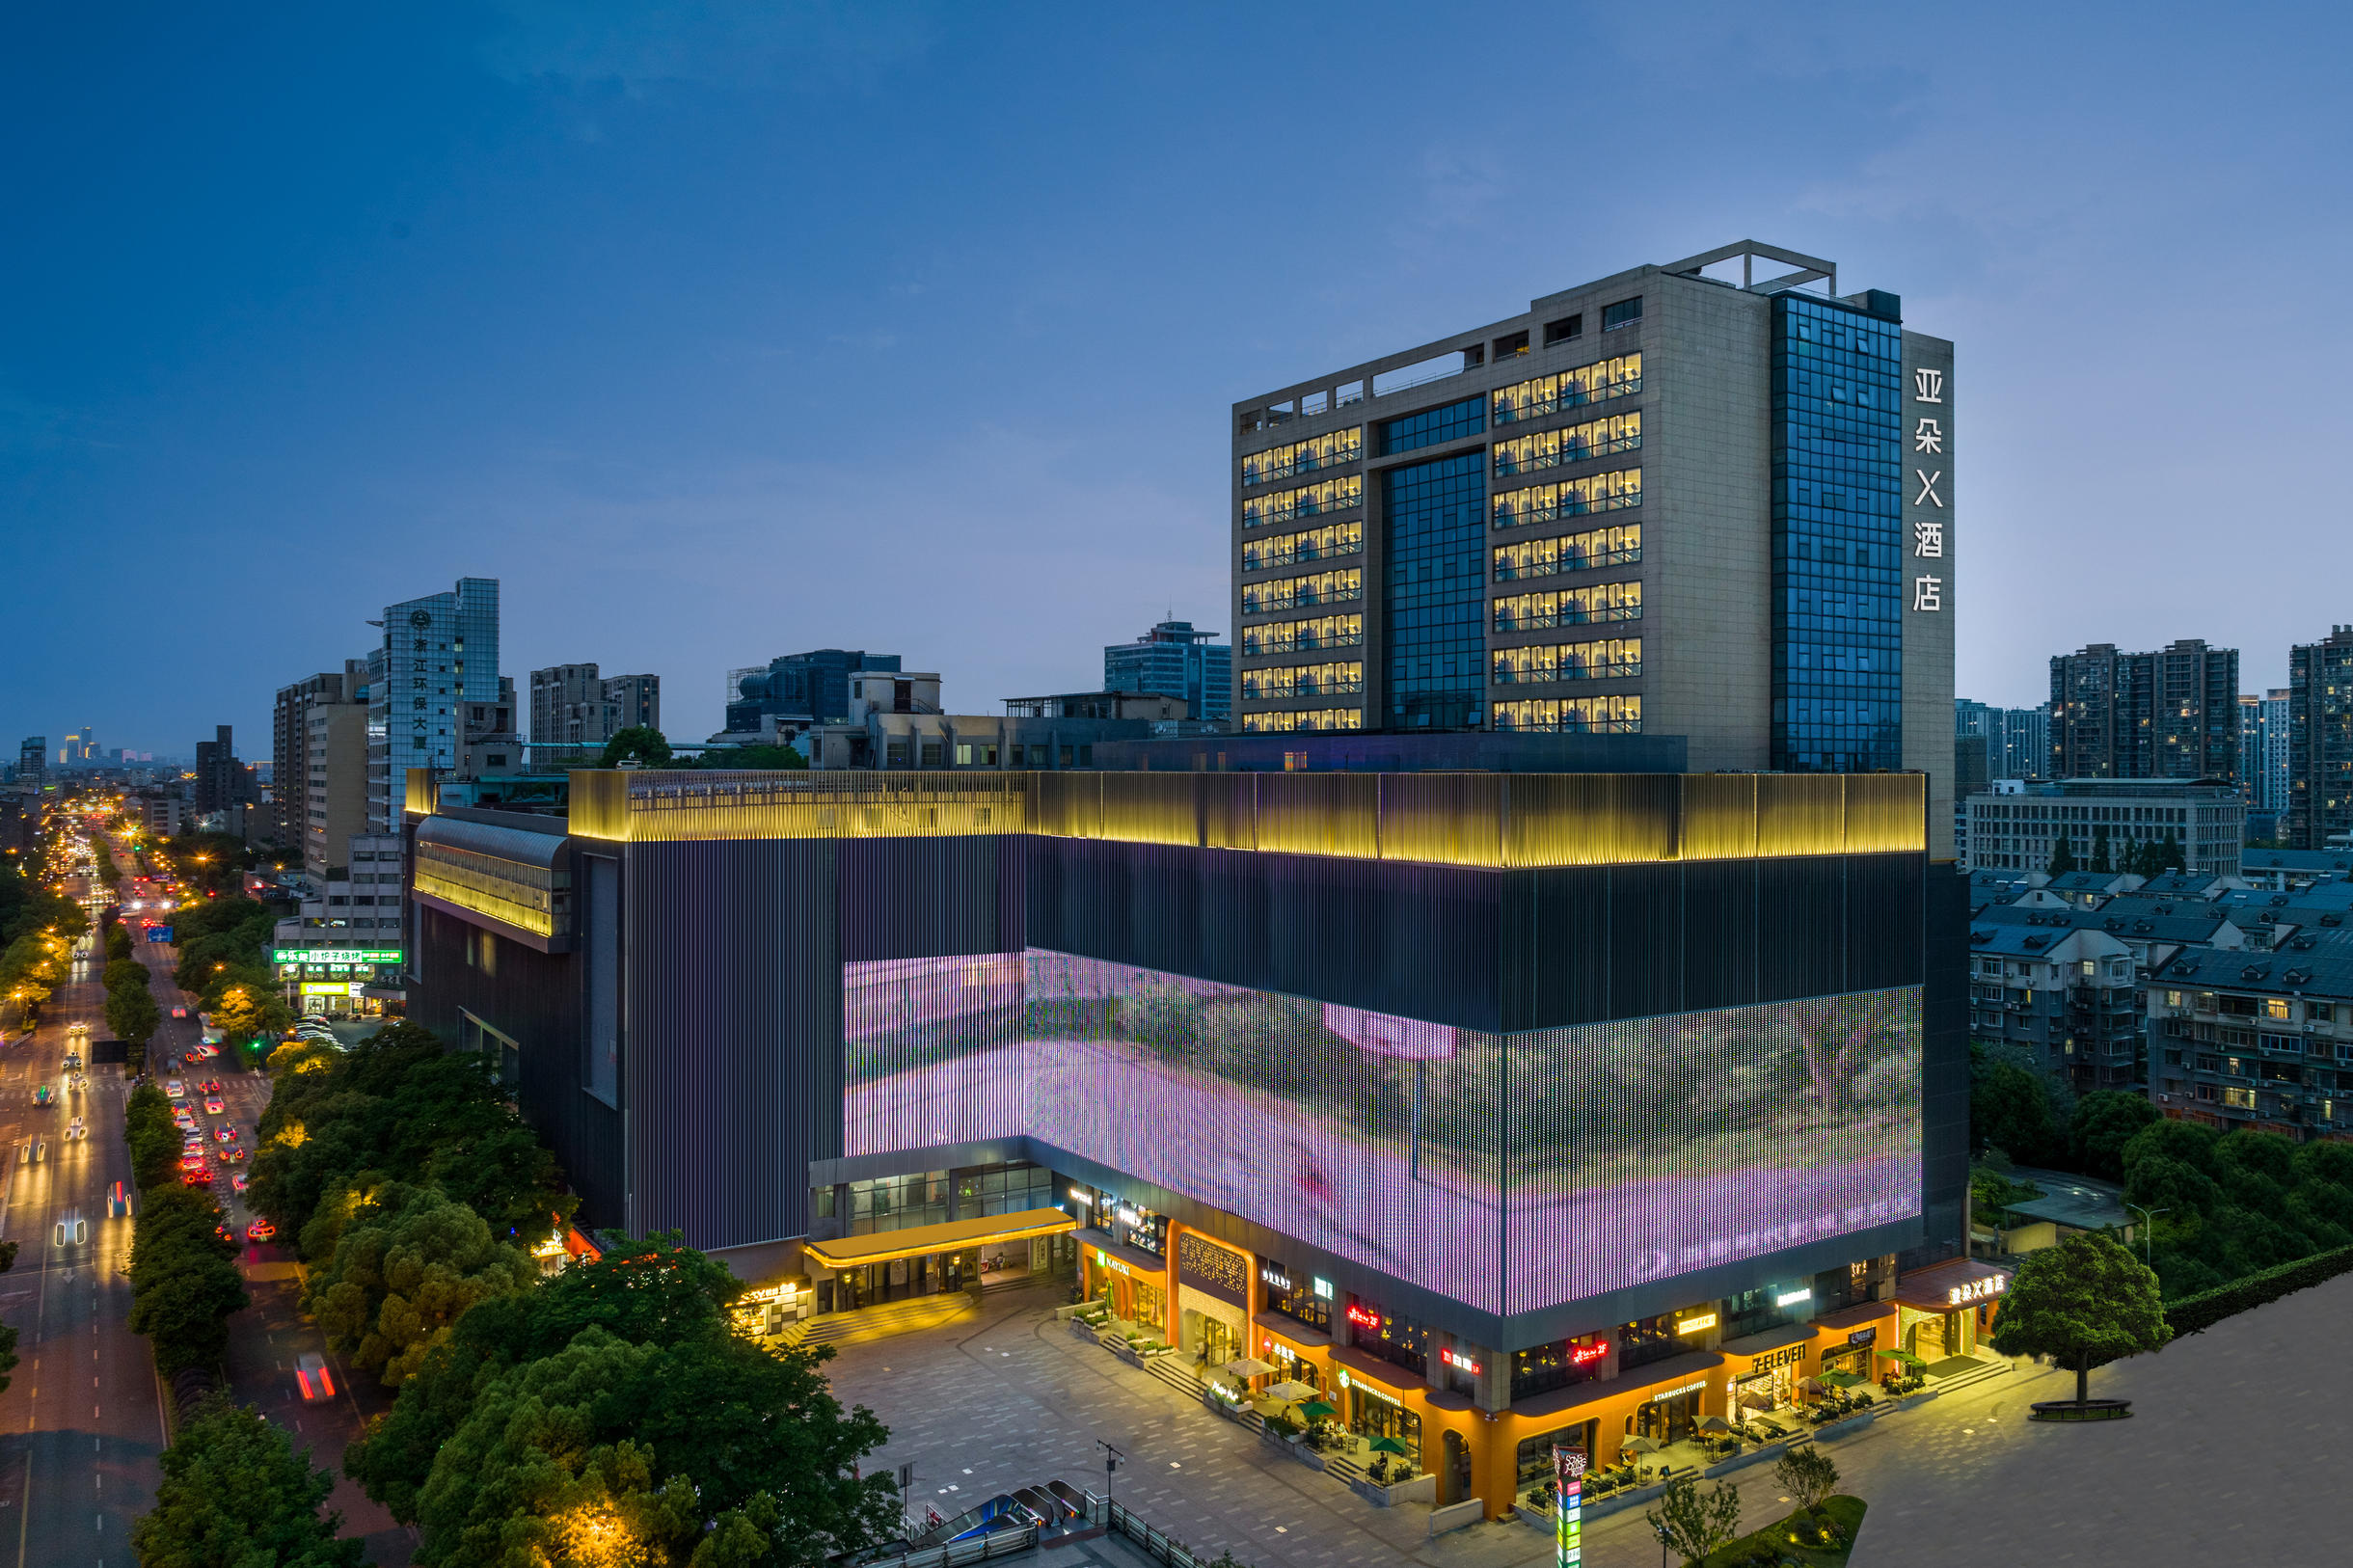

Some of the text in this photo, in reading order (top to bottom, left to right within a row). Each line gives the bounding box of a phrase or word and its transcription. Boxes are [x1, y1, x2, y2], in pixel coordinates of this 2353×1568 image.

[1913, 367, 1943, 611] 亚朵X酒店
[413, 638, 428, 750] 浙江环保大厦
[1106, 1257, 1129, 1276] NAYUKI
[1654, 1380, 1706, 1402] STARBUCKS COFFEE
